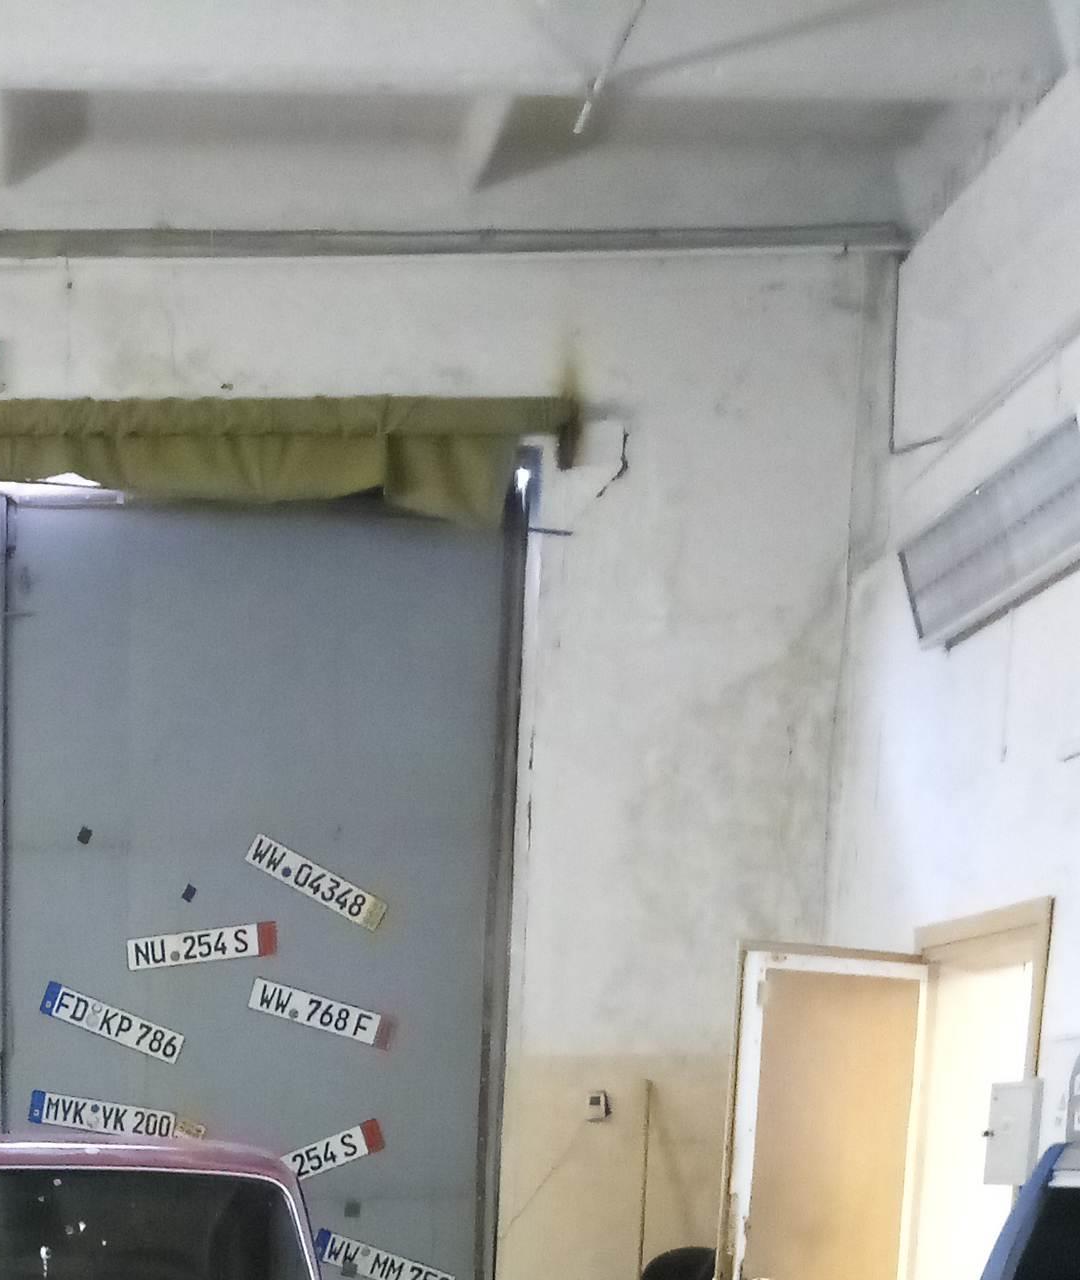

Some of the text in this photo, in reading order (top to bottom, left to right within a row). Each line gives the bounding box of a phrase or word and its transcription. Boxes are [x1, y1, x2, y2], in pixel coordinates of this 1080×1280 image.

[252, 838, 366, 917] WW 04348
[134, 939, 166, 966] NU
[55, 991, 89, 1022] FD
[260, 984, 292, 1014] WW
[45, 1097, 87, 1125] MYK
[292, 1141, 337, 1176] 254
[327, 1237, 360, 1263] WW
